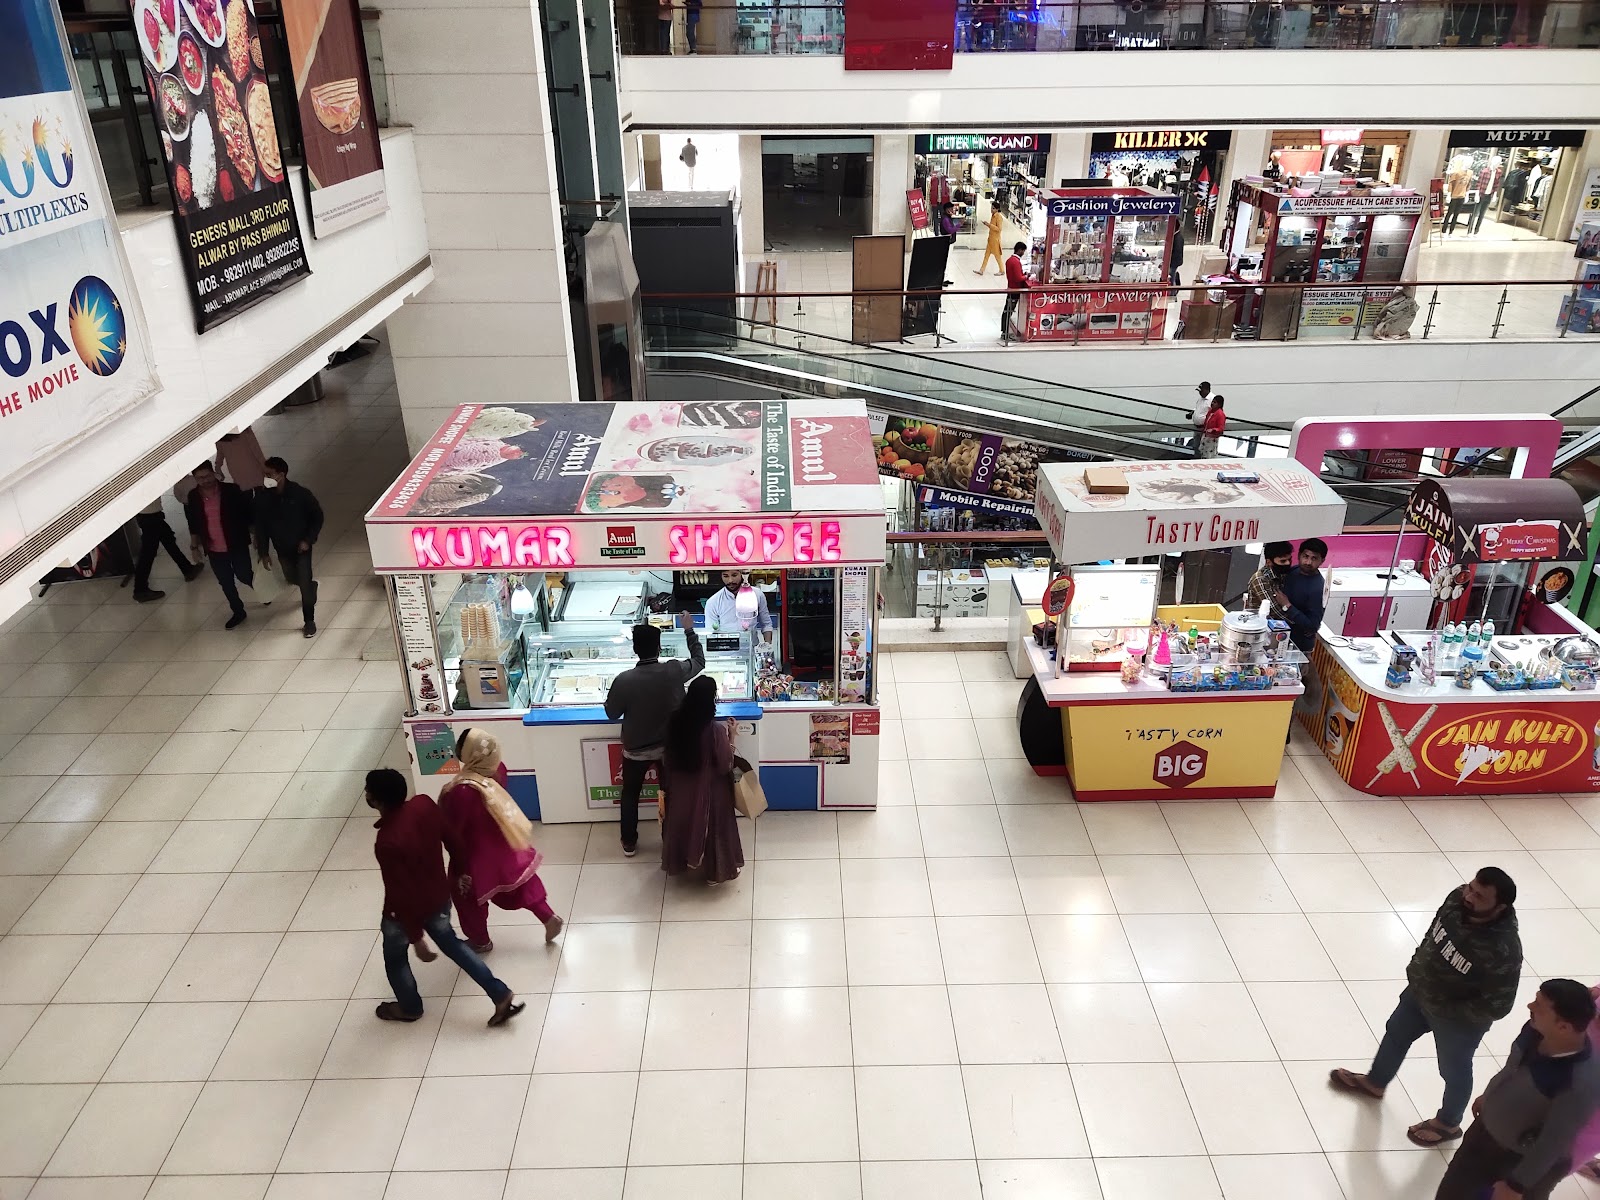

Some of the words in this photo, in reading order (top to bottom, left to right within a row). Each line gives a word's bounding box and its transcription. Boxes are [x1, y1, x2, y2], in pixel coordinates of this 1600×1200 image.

[936, 135, 969, 150] PETER
[972, 135, 1033, 150] ENGLAND
[1114, 131, 1182, 149] KILLER
[1486, 130, 1552, 141] MUFTI
[1053, 199, 1108, 214] Fashion
[1111, 198, 1176, 215] Jewelery
[1294, 198, 1346, 207] ACUPRESSURE
[1346, 197, 1373, 206] HEALTH
[1374, 197, 1394, 206] CARE
[1394, 197, 1423, 205] SYSTEM
[189, 221, 228, 249] GENESIS
[227, 214, 251, 234] MALL
[249, 207, 265, 225] 3RD
[264, 198, 290, 219] FLOOR
[198, 243, 229, 269] ALWAR
[228, 238, 240, 256] BY
[240, 230, 261, 251] PASS
[260, 217, 291, 242] BHIWADI
[196, 274, 220, 297] MOB.
[27, 363, 79, 403] MOVIE
[766, 403, 784, 424] The
[766, 425, 784, 454] Taste
[939, 427, 958, 437] GLOBAL
[958, 430, 973, 439] FOOD
[558, 433, 603, 477] Amul
[795, 418, 838, 483] Amul
[766, 456, 785, 470] of
[879, 461, 901, 470] NATURAL
[975, 446, 995, 483] FOOD
[1177, 462, 1246, 472] CORN
[766, 471, 787, 505] India
[938, 491, 980, 507] Mobile
[1415, 498, 1452, 532] JAIN
[608, 532, 636, 544] Amul
[1147, 515, 1203, 544] TASTY
[1210, 514, 1260, 542] CORN
[1412, 514, 1447, 544] KULFI
[1502, 537, 1525, 545] MERRY
[1525, 535, 1557, 545] CHRISTMAS
[412, 526, 576, 567] KUMAR
[669, 520, 841, 565] SHOPEE
[1187, 727, 1223, 740] CORN
[1436, 718, 1501, 747] JAIN
[1504, 717, 1576, 744] KULFI
[1157, 754, 1204, 778] BIG
[597, 789, 620, 798] The
[1440, 940, 1456, 962] THE
[1450, 950, 1473, 975] WILD
